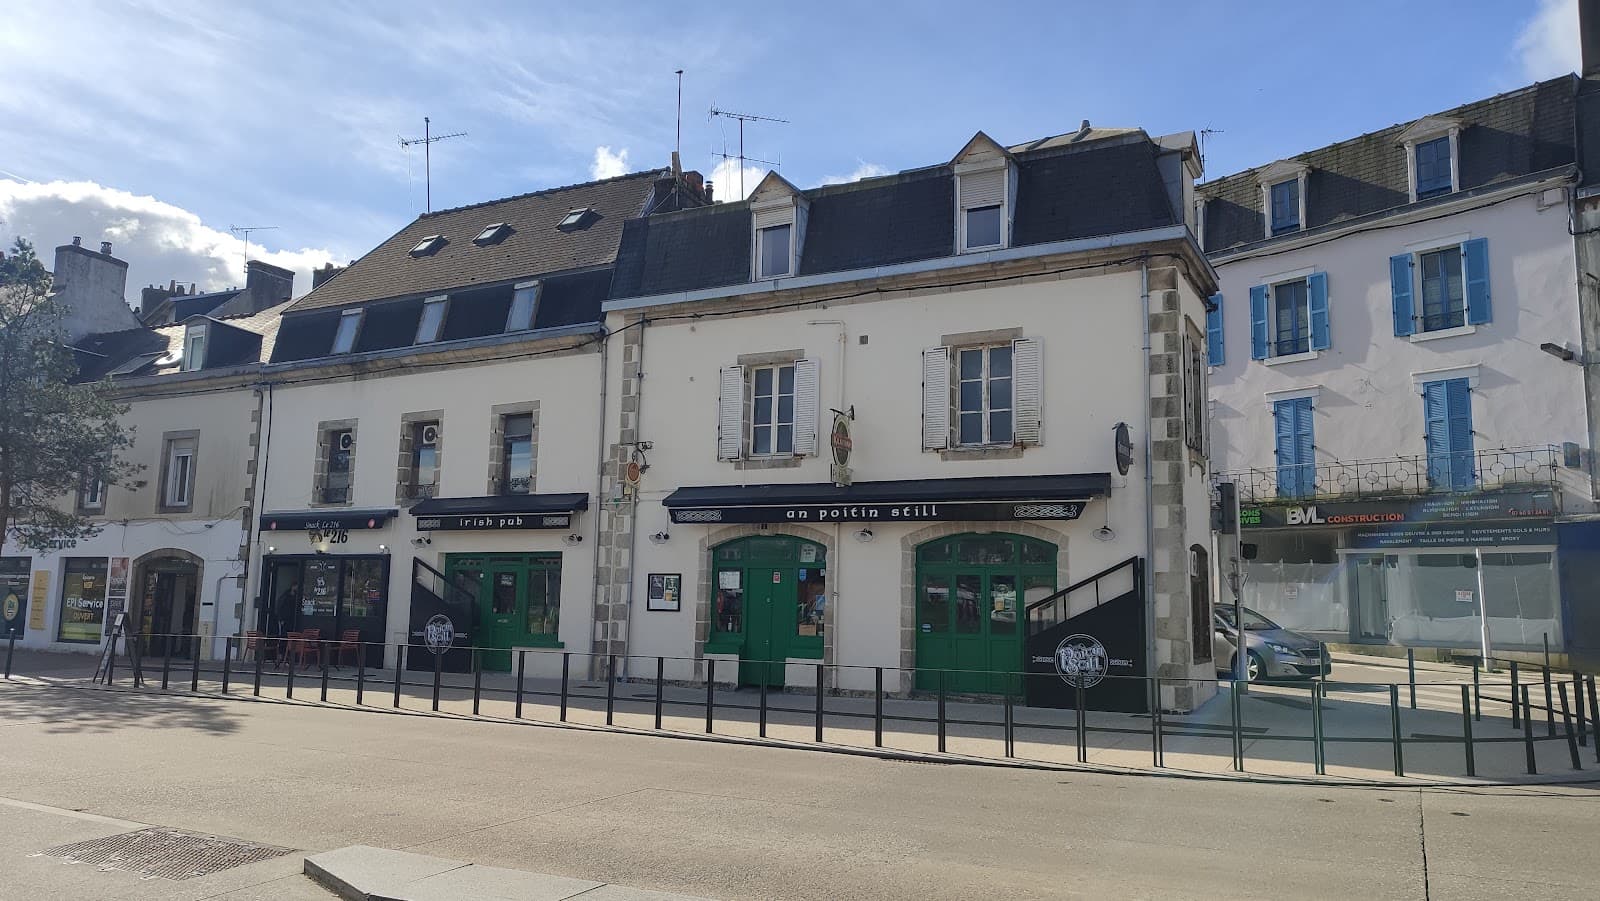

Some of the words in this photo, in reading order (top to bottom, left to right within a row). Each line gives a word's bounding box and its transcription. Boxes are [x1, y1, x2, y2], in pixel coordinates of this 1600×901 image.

[786, 510, 808, 519] an
[891, 505, 937, 517] still
[1287, 506, 1325, 525] BVL
[1327, 513, 1404, 524] CONSTRUCTION
[460, 517, 493, 527] irish
[500, 516, 523, 527] pub
[330, 529, 348, 543] 216
[78, 598, 104, 609] Service
